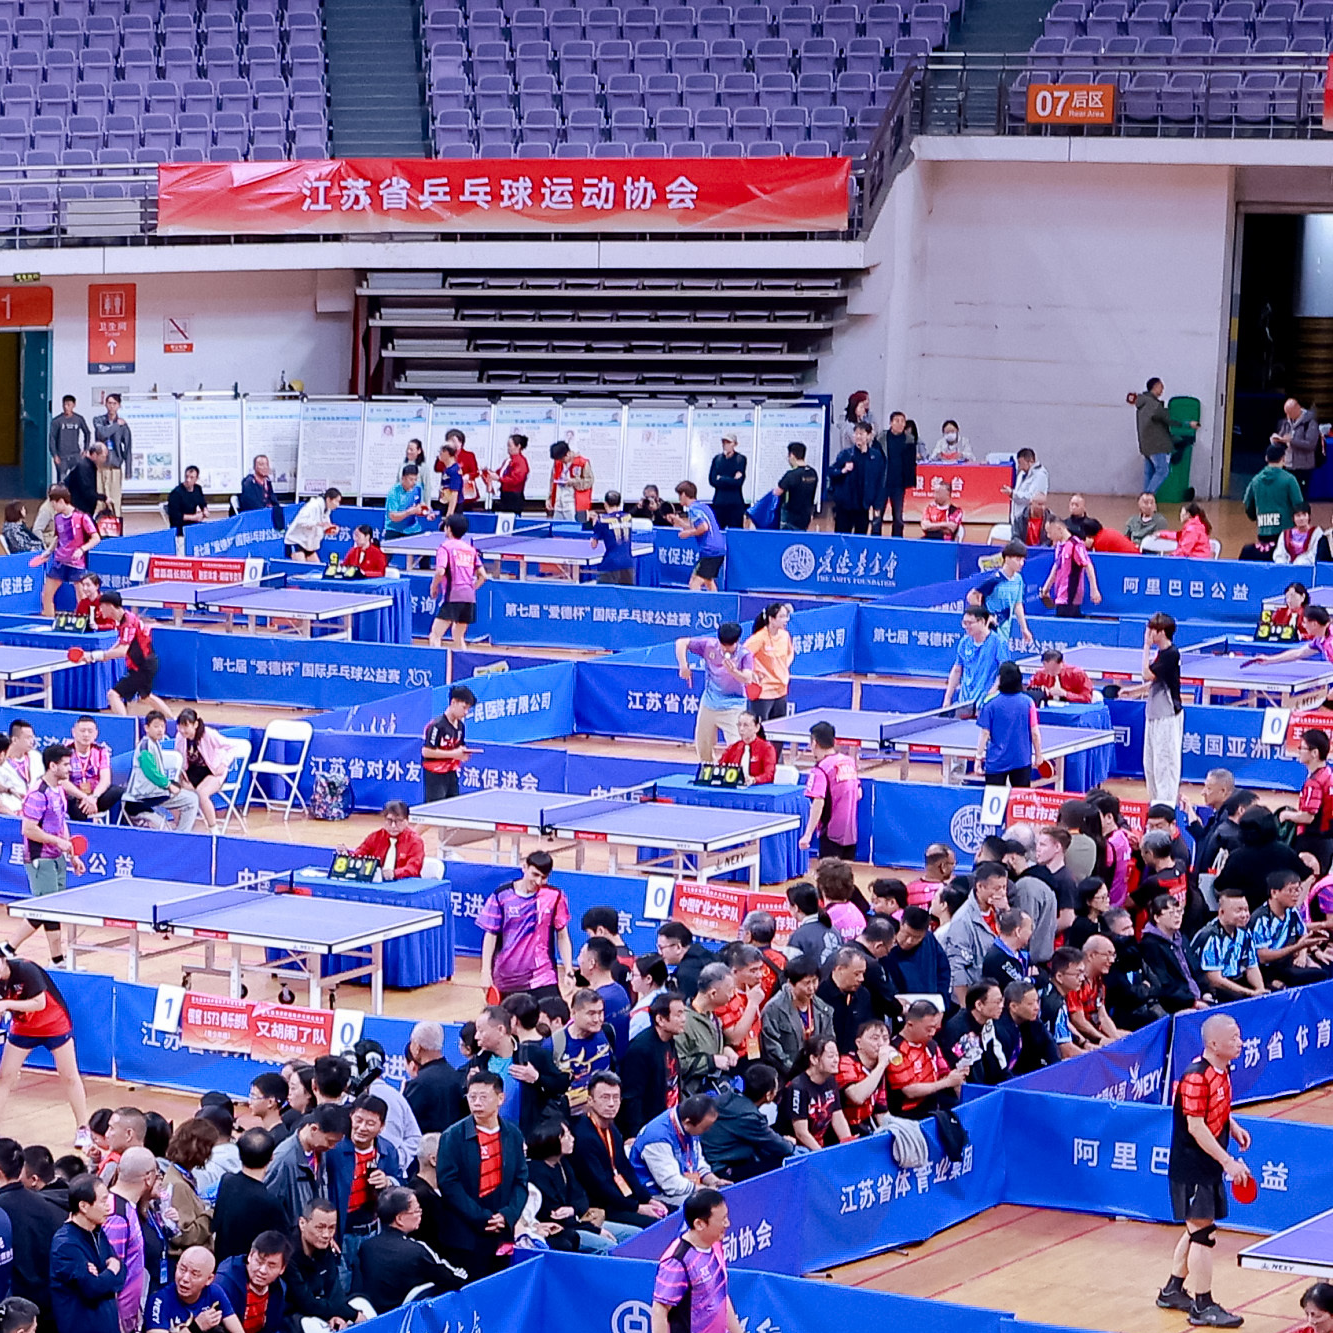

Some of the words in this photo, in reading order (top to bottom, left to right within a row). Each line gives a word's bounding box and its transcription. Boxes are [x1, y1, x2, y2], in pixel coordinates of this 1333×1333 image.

[1035, 90, 1069, 117] 07
[1071, 90, 1104, 108] 后区
[301, 175, 699, 213] 江苏省乒乓球运动协会
[1123, 577, 1249, 601] 阿里巴巴公益
[655, 887, 665, 907] 0
[165, 997, 173, 1019] 1
[341, 1021, 354, 1044] 0
